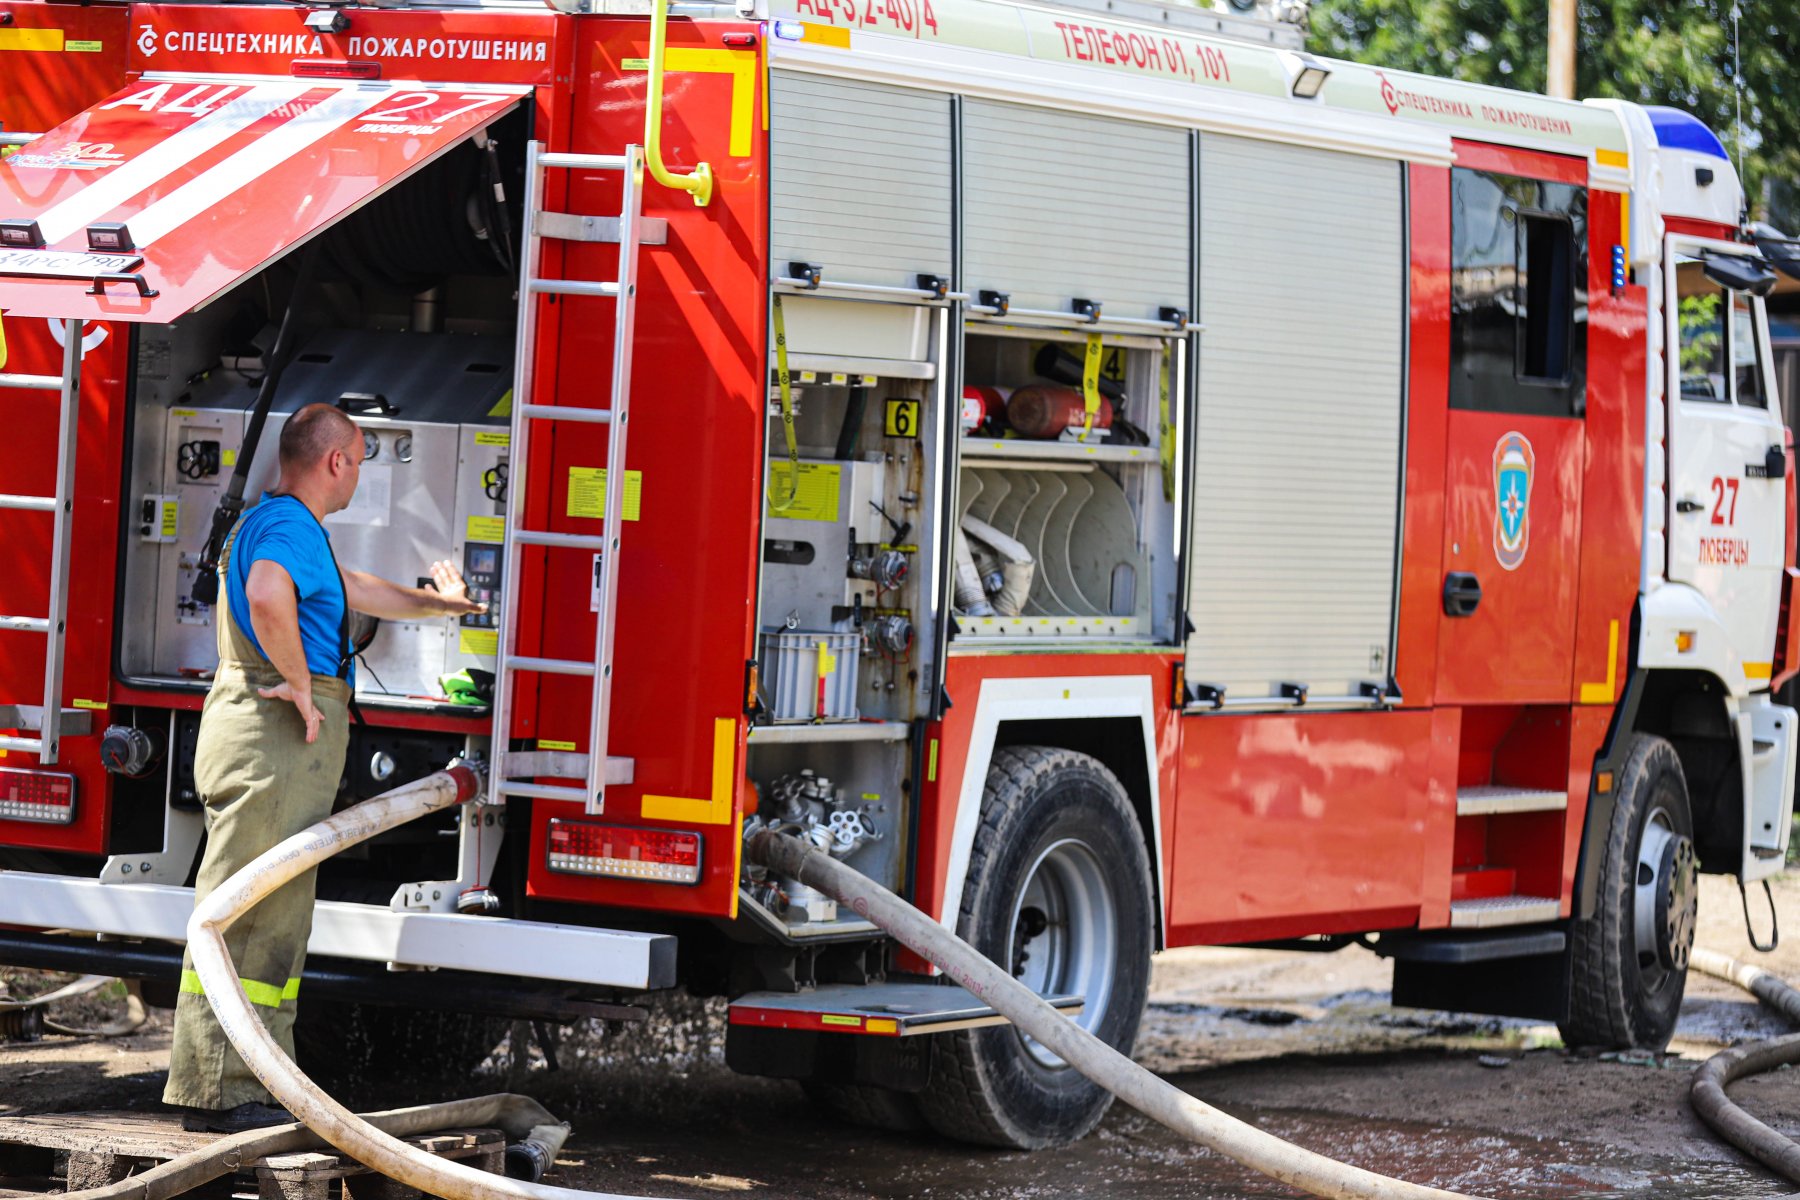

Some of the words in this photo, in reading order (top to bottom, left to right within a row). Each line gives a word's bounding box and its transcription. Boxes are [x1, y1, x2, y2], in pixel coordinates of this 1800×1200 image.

[164, 30, 324, 55] СПЕЦТЕХНИКА
[348, 36, 547, 61] ПОЖАРОТУШЕНИЯ
[1054, 21, 1162, 71] ТЕЛЕФОН
[1162, 38, 1195, 82] 01,
[1196, 44, 1231, 82] 101
[98, 83, 240, 118] АЦ
[358, 92, 510, 124] 27
[1396, 90, 1474, 120] СПЕЦТЕХНИКА
[1481, 104, 1573, 135] ПОЖАРОТУШЕНИЯ
[1105, 348, 1121, 381] 4
[894, 401, 911, 436] 6
[1711, 475, 1739, 526] 27
[1699, 537, 1749, 570] ЛЮБЕРЦЫ
